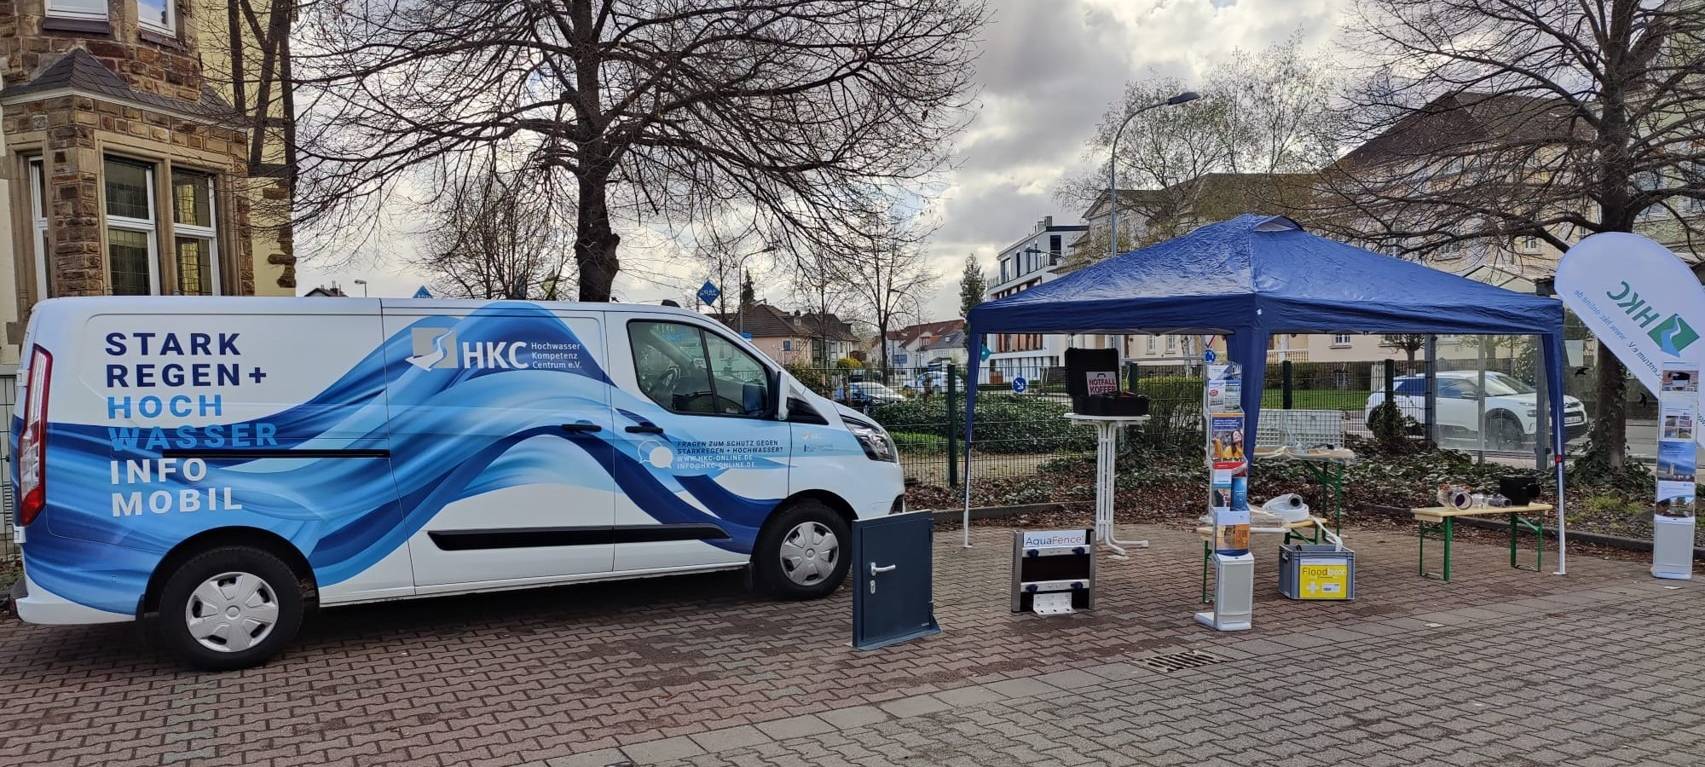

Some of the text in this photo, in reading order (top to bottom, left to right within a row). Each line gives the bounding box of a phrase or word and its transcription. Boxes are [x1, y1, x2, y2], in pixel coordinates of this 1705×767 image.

[105, 332, 241, 356] STARK
[531, 342, 581, 351] Hochwasser
[462, 341, 530, 369] HKC
[532, 352, 578, 361] Kompetenz
[532, 360, 582, 369] Centrum e.V.
[1088, 378, 1116, 386] NOTFALL
[1089, 385, 1116, 394] KOFFER
[107, 395, 223, 419] HOCH
[107, 423, 278, 451] WASSER
[677, 447, 725, 455] STARKREGEN
[111, 458, 207, 485] INFO
[111, 487, 243, 517] MOBIL
